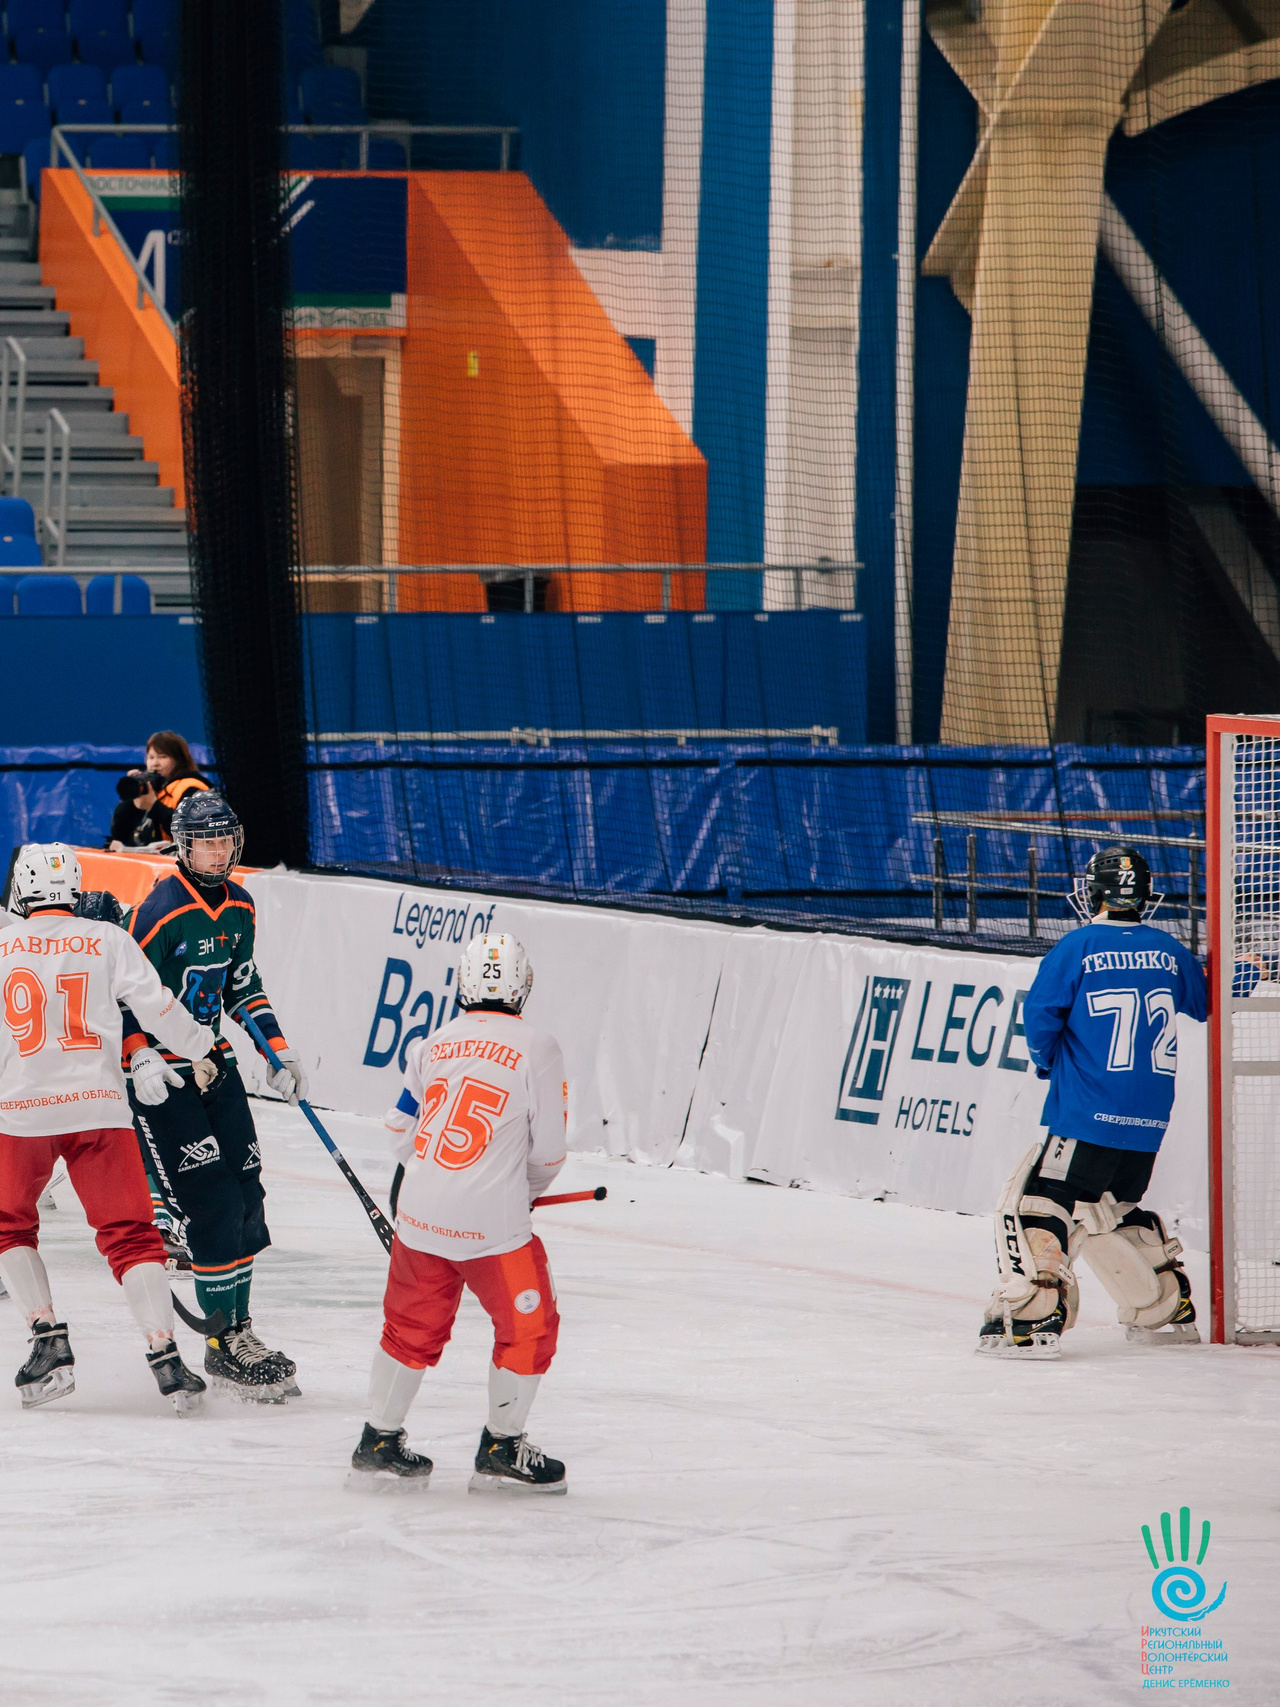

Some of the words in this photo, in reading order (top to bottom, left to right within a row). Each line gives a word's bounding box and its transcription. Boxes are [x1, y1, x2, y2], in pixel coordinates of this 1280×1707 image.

[208, 820, 229, 828] CCM
[49, 892, 61, 901] 91
[1118, 870, 1136, 886] 72
[392, 891, 470, 949] Legend
[470, 903, 496, 938] of
[482, 963, 502, 979] 25
[3, 967, 103, 1058] 91
[911, 980, 1030, 1073] LEGE
[1085, 987, 1178, 1077] 72
[430, 1040, 523, 1072] ЗЕЛЕНИН
[0, 1092, 80, 1111] СВЕРДЛОВСКАЯ
[81, 1089, 123, 1101] ОБЛАСТЬ
[895, 1095, 977, 1137] HOTELS
[415, 1076, 511, 1171] 25
[431, 1225, 485, 1240] ОБЛАСТЬ
[1003, 1213, 1026, 1277] CCM
